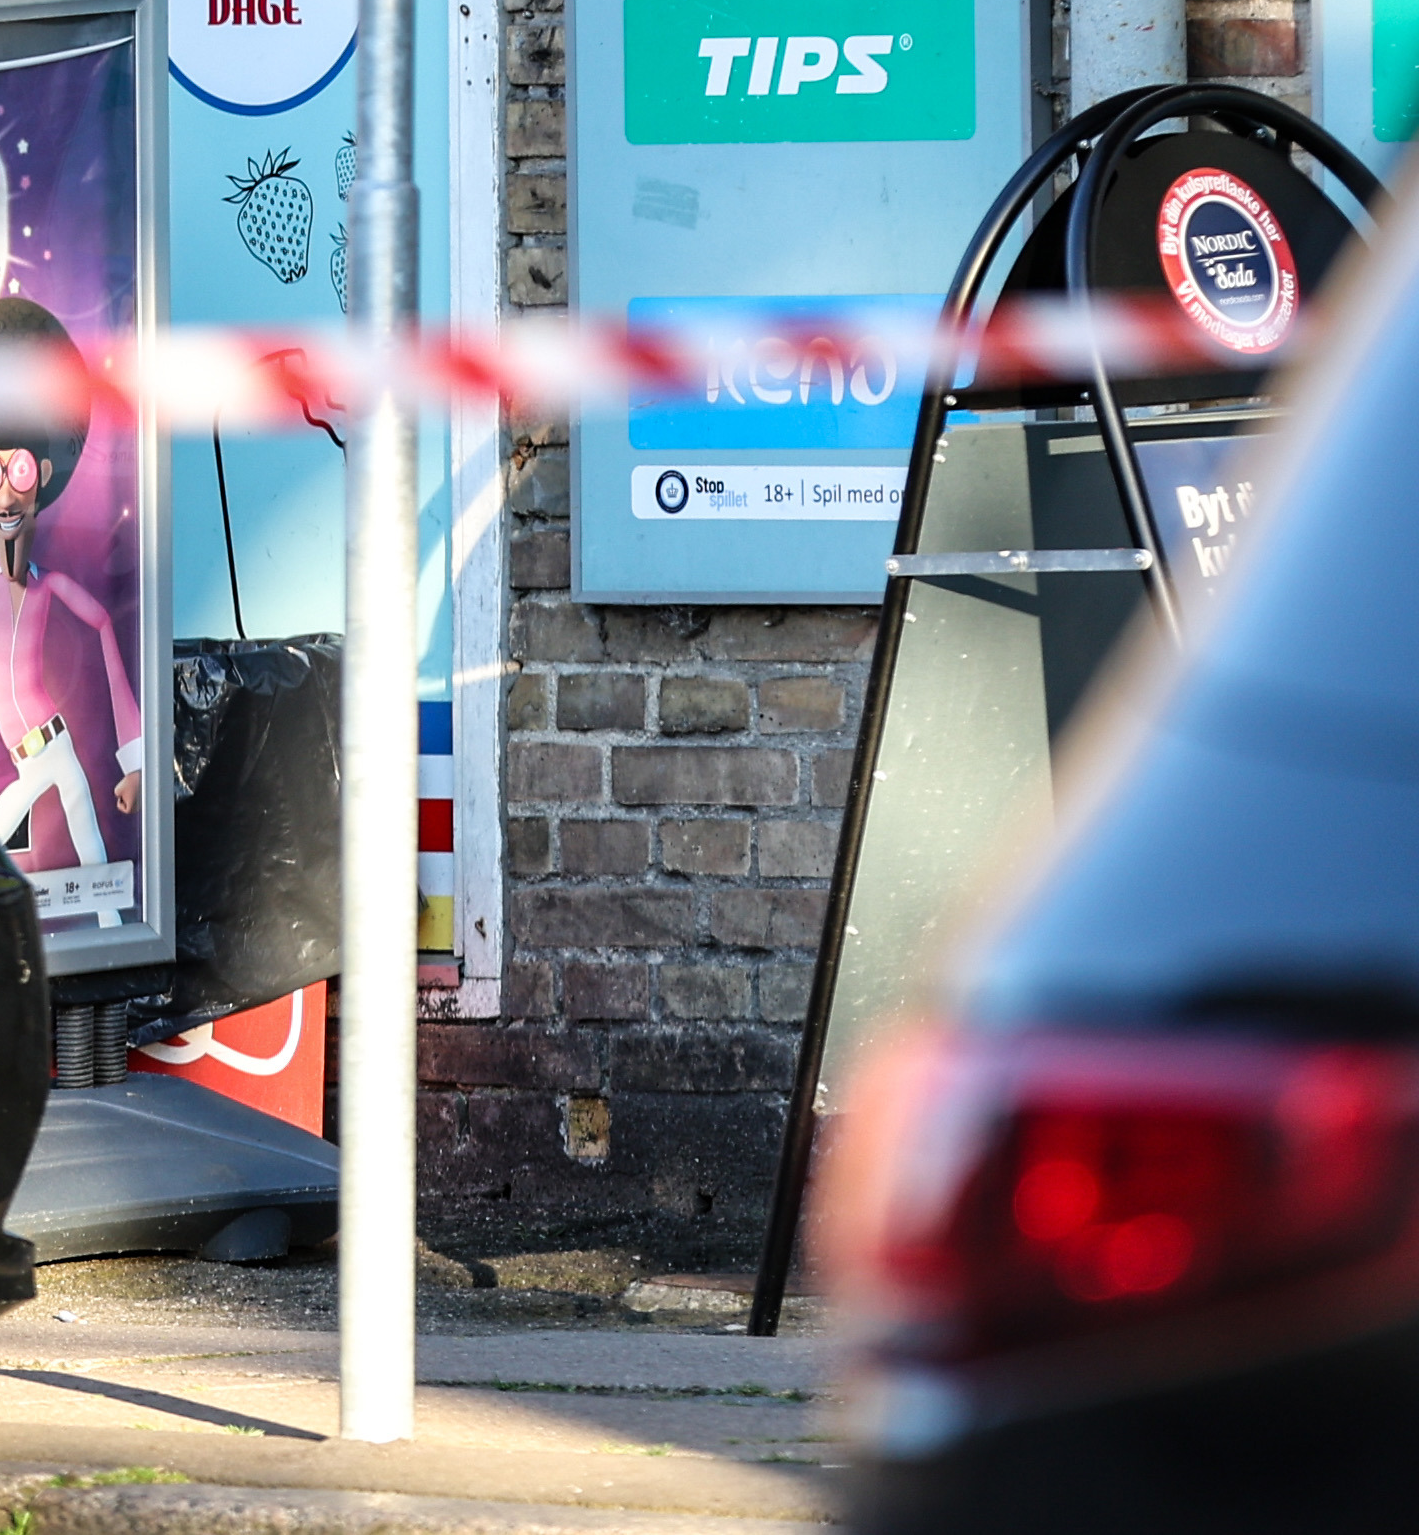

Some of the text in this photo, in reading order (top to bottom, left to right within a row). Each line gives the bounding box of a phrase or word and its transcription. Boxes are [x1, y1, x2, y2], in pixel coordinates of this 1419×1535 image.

[697, 34, 894, 97] TIPS
[1161, 174, 1281, 255] Byt din kulsyreflaske her
[1191, 230, 1257, 256] NORDIC
[1215, 262, 1257, 289] Soda
[1177, 280, 1196, 303] Vi
[695, 476, 724, 495] Stop
[763, 484, 794, 503] 18+
[813, 484, 841, 507] Spil
[847, 484, 884, 503] med
[709, 490, 748, 511] spillet
[1176, 485, 1235, 537] Byt
[65, 881, 80, 894] 18+
